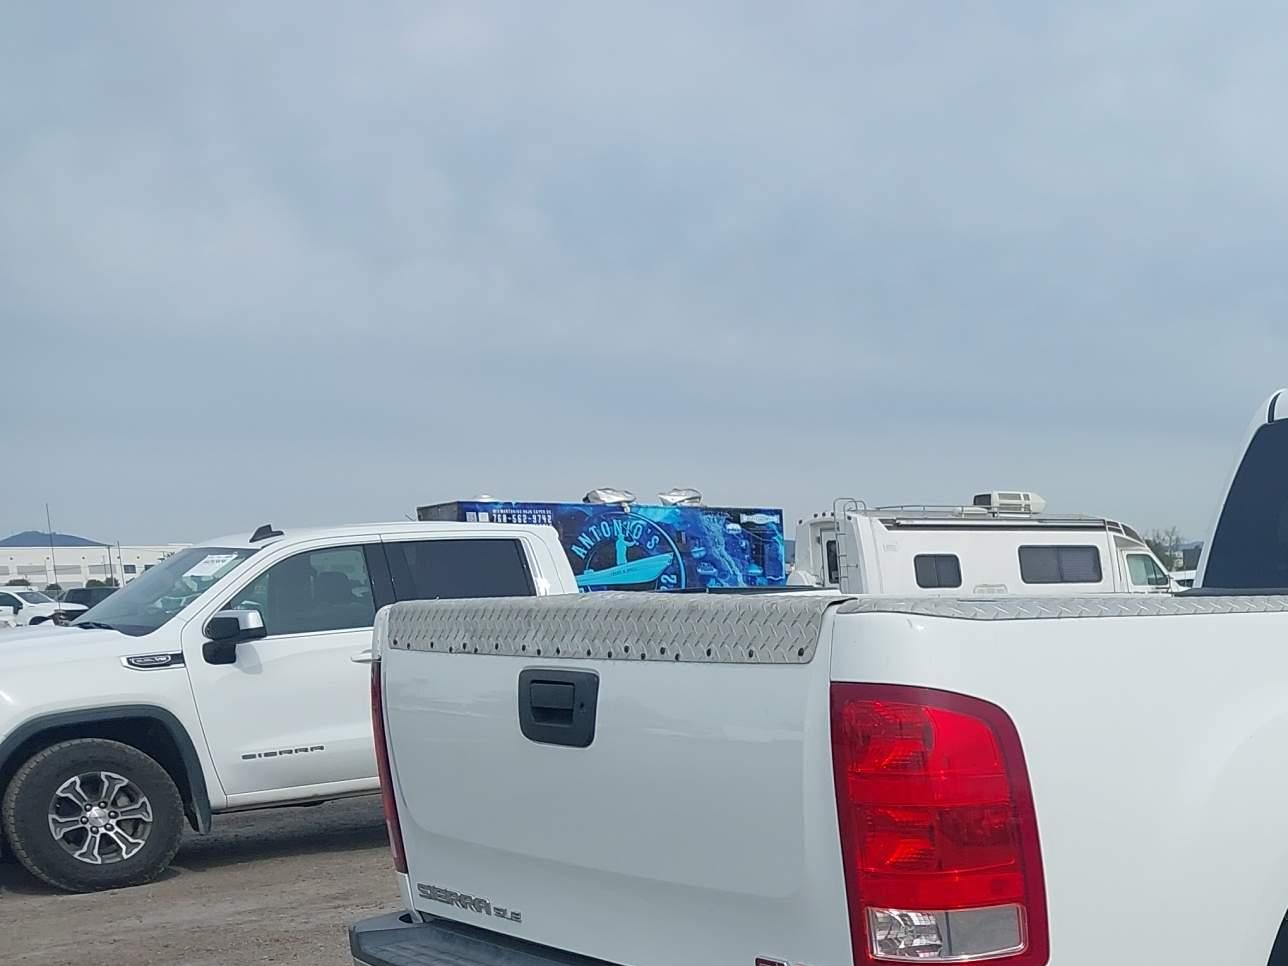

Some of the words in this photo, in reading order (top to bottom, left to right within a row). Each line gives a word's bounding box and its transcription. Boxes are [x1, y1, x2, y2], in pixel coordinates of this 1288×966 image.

[571, 519, 660, 560] ANTONIO'S
[241, 745, 325, 760] SIERRA
[416, 883, 492, 916] SIERRA
[493, 906, 522, 924] SLE
